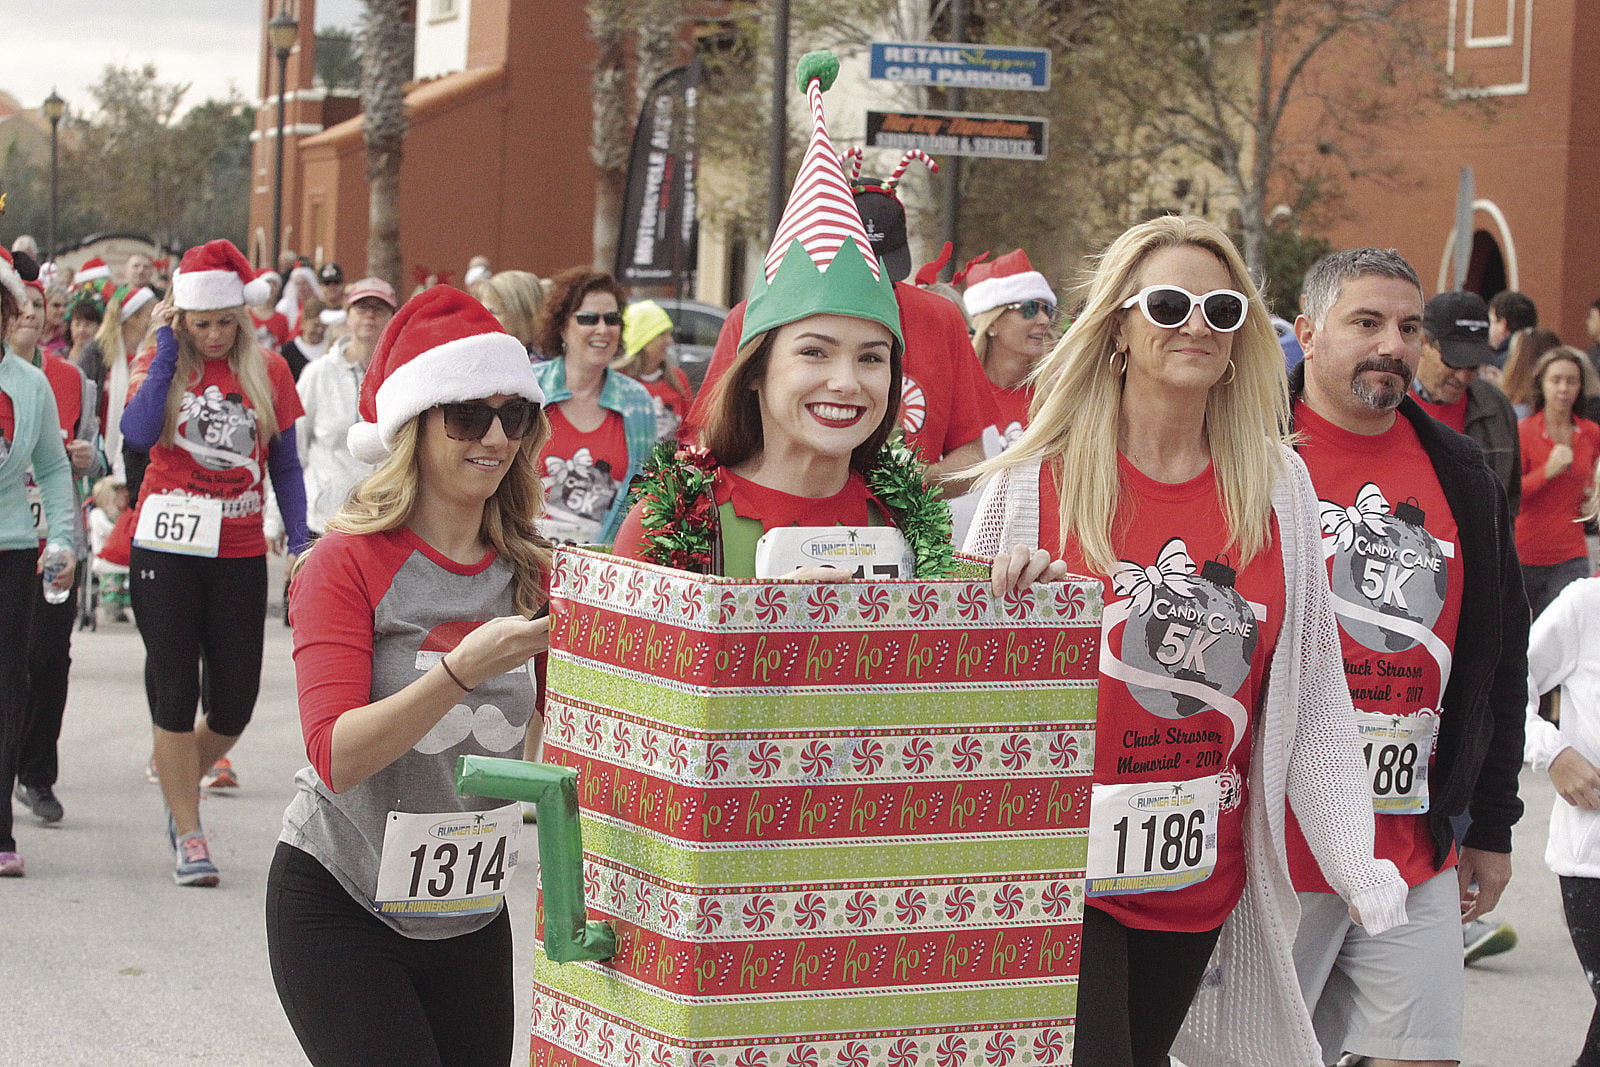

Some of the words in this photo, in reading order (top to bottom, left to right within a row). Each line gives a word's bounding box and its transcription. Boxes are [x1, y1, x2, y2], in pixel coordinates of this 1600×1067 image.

[885, 47, 963, 64] RETAIL
[886, 66, 931, 82] CAR
[936, 68, 1032, 87] PARKING
[633, 152, 667, 265] MOTORCYCLE
[205, 422, 237, 448] 5K
[155, 512, 200, 543] 657
[567, 489, 599, 514] 5K
[1361, 558, 1415, 610] 5K
[588, 610, 606, 656] ho
[616, 616, 633, 664] ho
[644, 624, 662, 670] ho
[674, 630, 692, 678] ho
[752, 635, 781, 682] ho
[805, 634, 832, 682] ho
[855, 634, 882, 680] ho
[906, 633, 932, 679] ho
[956, 632, 982, 678] ho
[1004, 631, 1029, 676] ho
[1052, 630, 1080, 676] ho
[1156, 623, 1221, 675] 5K
[1342, 658, 1373, 676] huck
[1350, 684, 1392, 701] morial
[1117, 752, 1181, 775] Memorial
[1196, 750, 1223, 768] 2017
[1123, 728, 1161, 748] Chuck
[1165, 728, 1223, 745] Strasser
[584, 760, 600, 806] ho
[612, 768, 628, 814] ho
[638, 776, 654, 824] ho
[664, 785, 682, 832] ho
[746, 790, 774, 836] ho
[798, 788, 826, 834] ho
[850, 787, 876, 832] ho
[900, 786, 926, 830] ho
[950, 784, 976, 828] ho
[998, 782, 1024, 827] ho
[1046, 780, 1072, 824] ho
[408, 836, 506, 898] 1314
[1113, 809, 1205, 874] 1186
[631, 928, 646, 976] ho
[657, 938, 674, 986] ho
[740, 944, 768, 990] ho
[792, 942, 820, 986] ho
[842, 938, 870, 984] ho
[892, 936, 920, 982] ho
[942, 934, 968, 978] ho
[990, 931, 1017, 976] ho
[1038, 928, 1064, 972] ho
